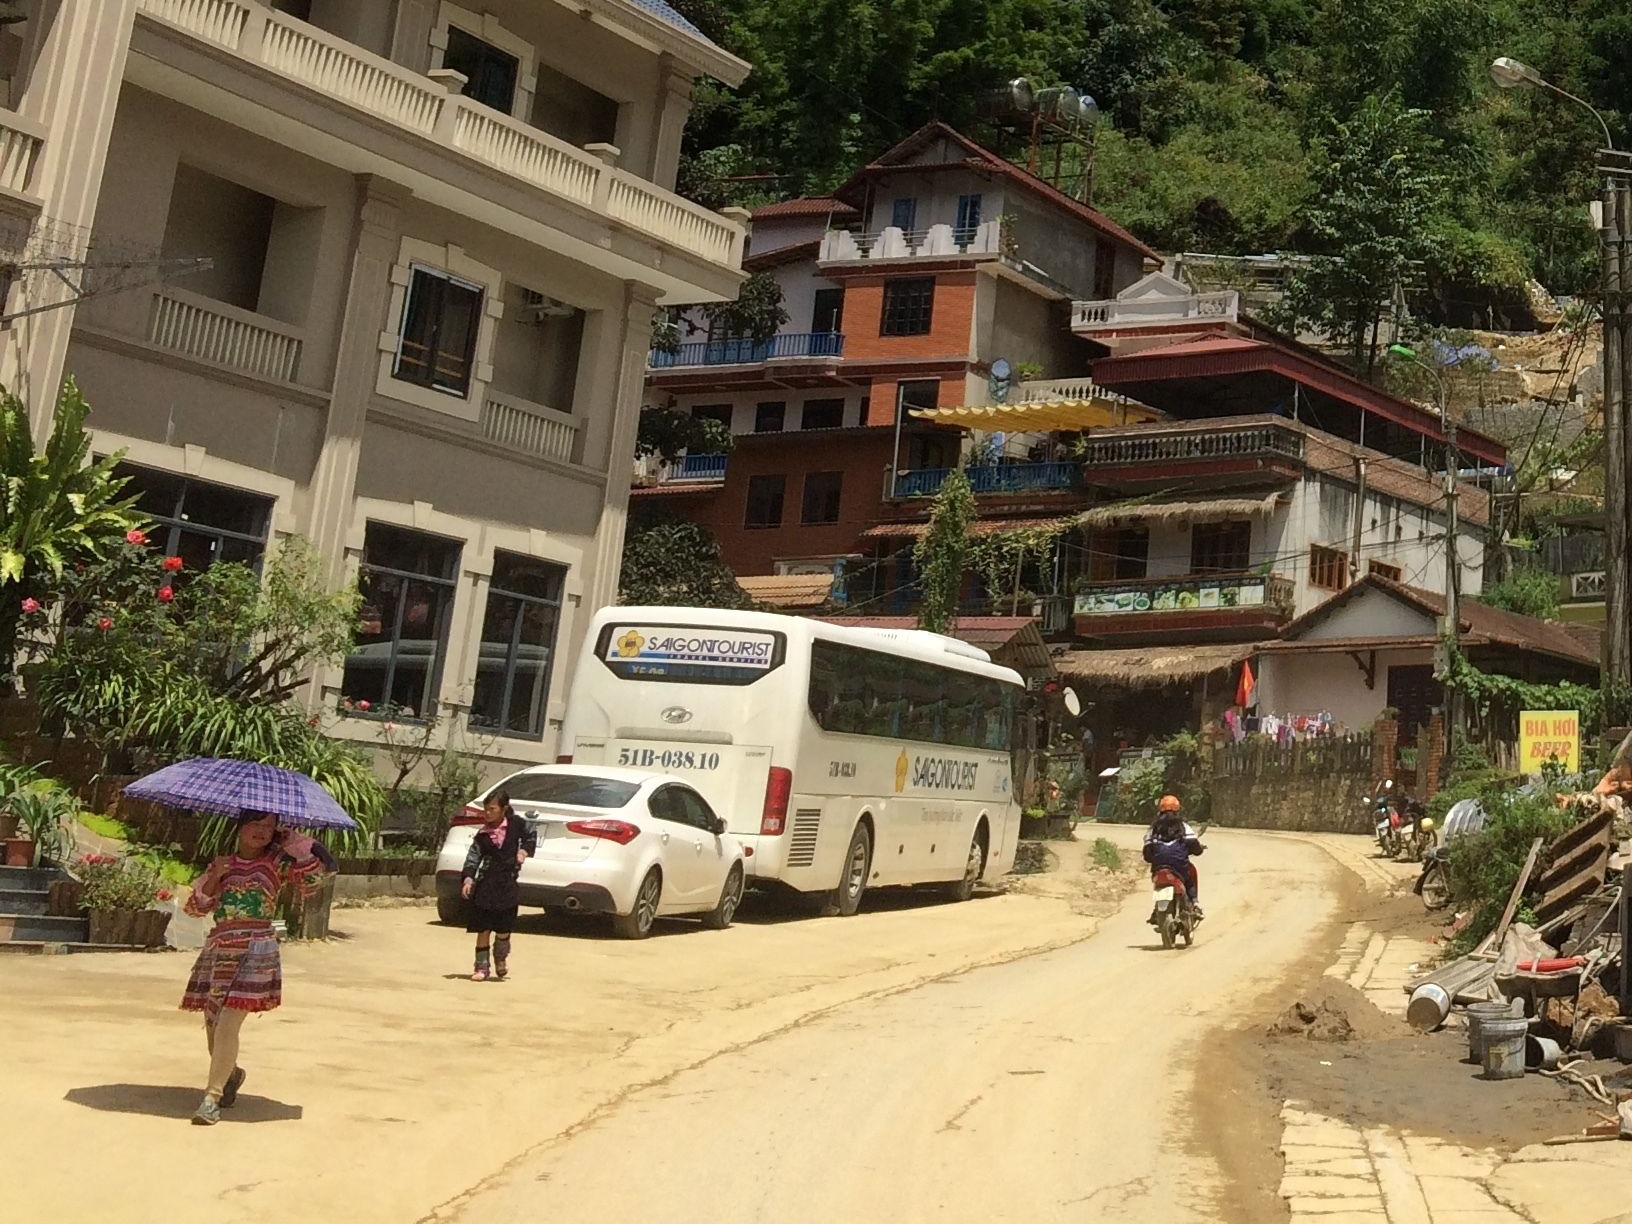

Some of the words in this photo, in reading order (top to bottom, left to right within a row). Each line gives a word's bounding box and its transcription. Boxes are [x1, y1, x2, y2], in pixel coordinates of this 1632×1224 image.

[648, 636, 772, 657] SAIGONTOURIST
[1525, 719, 1548, 737] BIA
[1553, 716, 1576, 737] HƠI
[618, 748, 720, 771] 51B-038.10
[1529, 740, 1571, 758] BEER
[912, 756, 979, 791] SAIGONTOURIST
